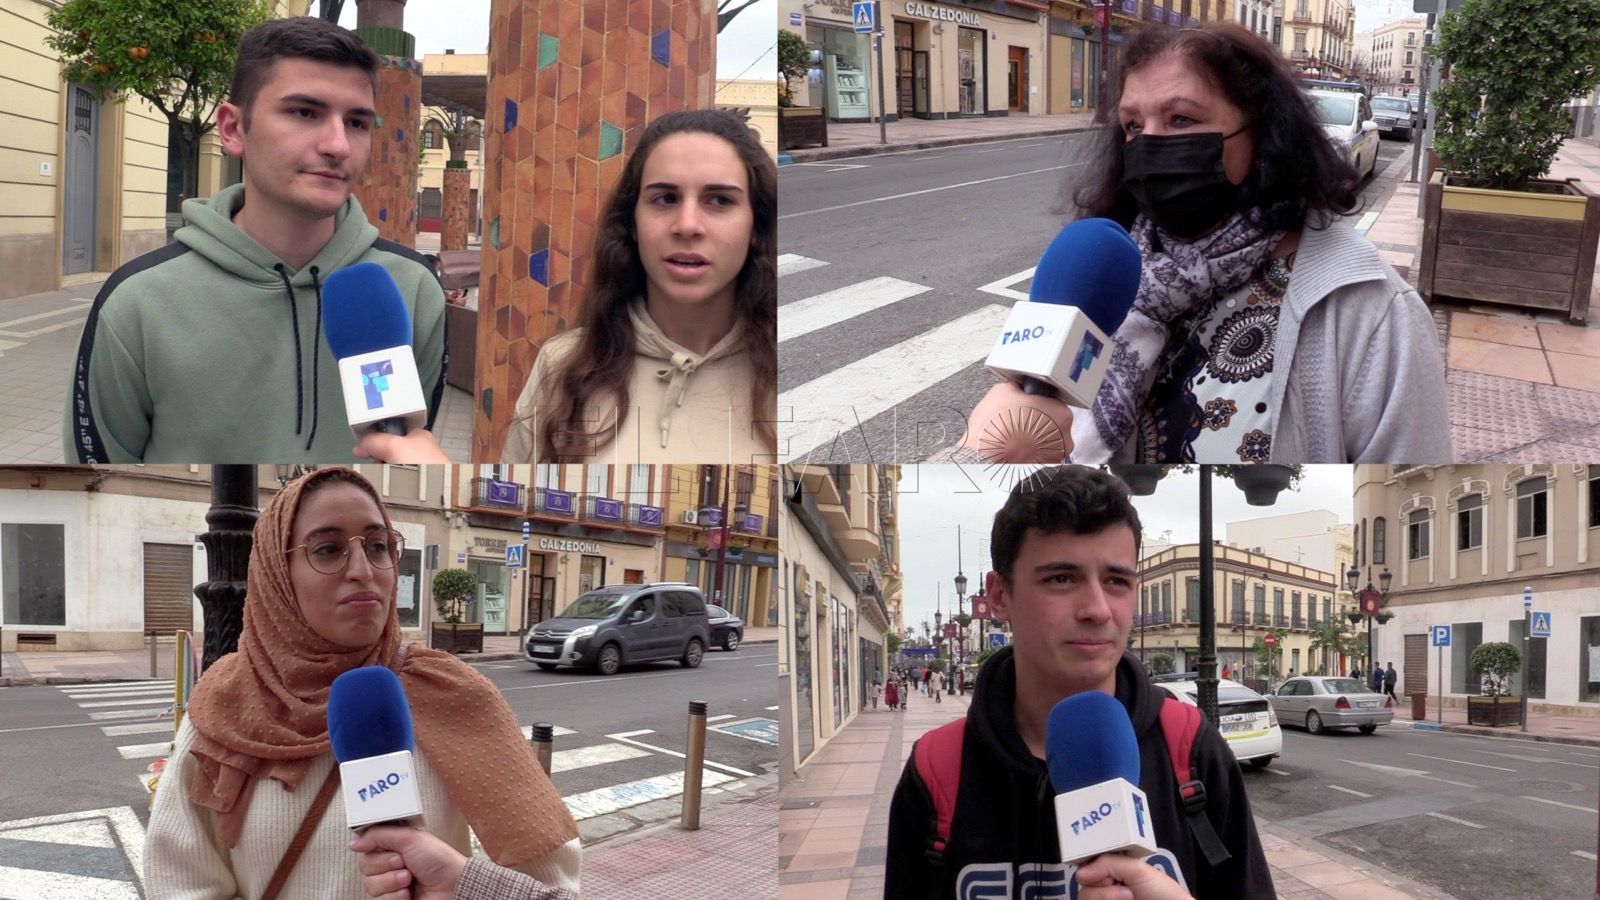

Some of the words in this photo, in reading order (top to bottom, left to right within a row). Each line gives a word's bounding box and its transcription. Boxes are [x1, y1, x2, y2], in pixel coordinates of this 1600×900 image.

[905, 1, 981, 26] CALZEDONIA
[539, 537, 601, 554] CALZEDONIA
[1436, 627, 1447, 644] P
[358, 773, 400, 802] FARO
[1071, 802, 1112, 835] FARO
